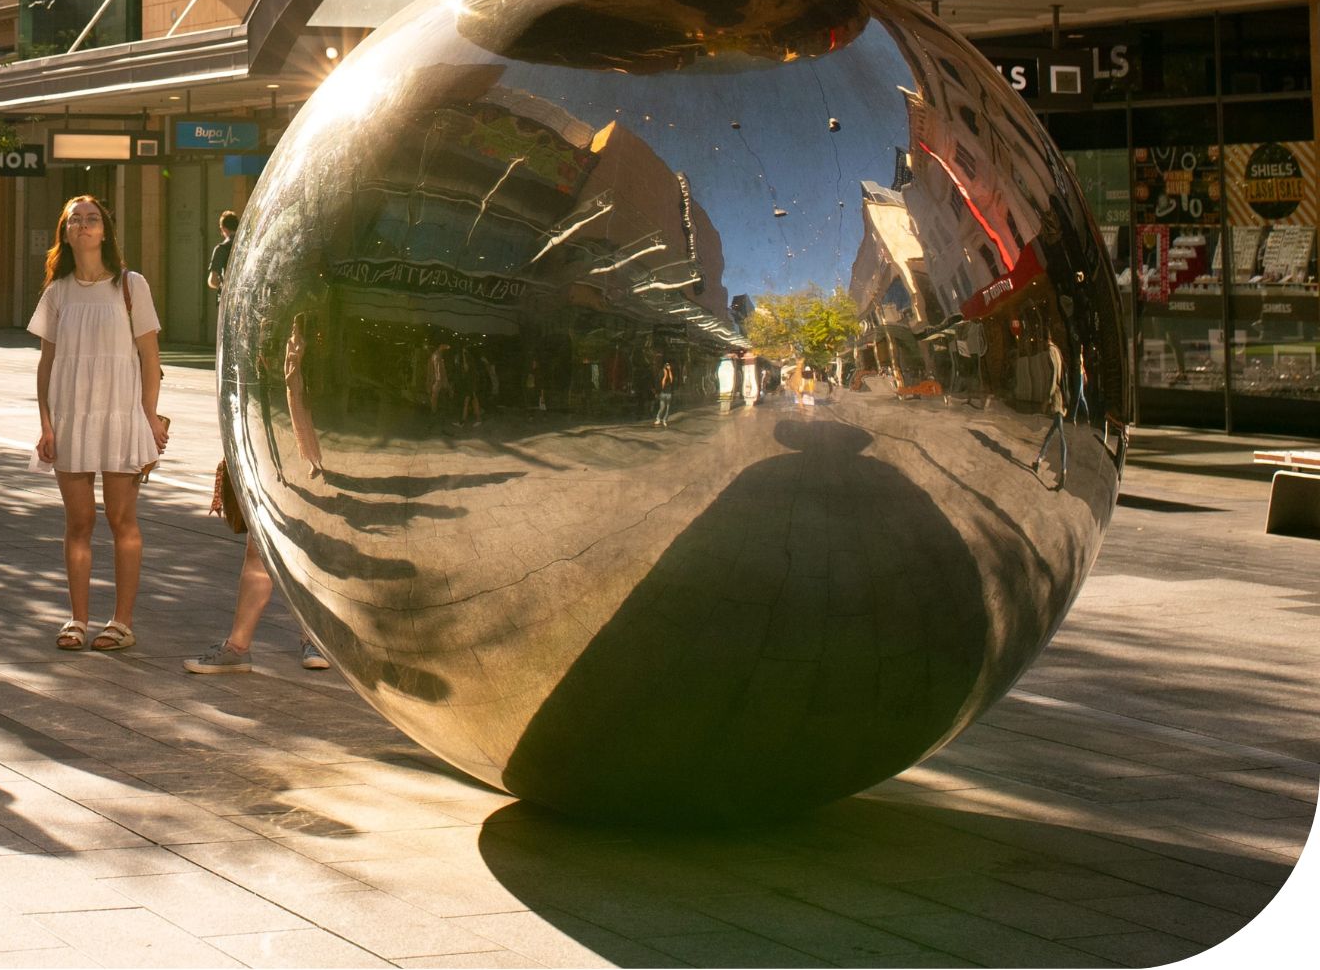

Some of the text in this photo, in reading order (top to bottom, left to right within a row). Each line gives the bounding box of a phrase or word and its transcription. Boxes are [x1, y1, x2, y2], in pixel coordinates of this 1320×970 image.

[194, 126, 223, 138] Bupa
[1250, 163, 1294, 177] SHIELS
[1280, 180, 1304, 199] SALE
